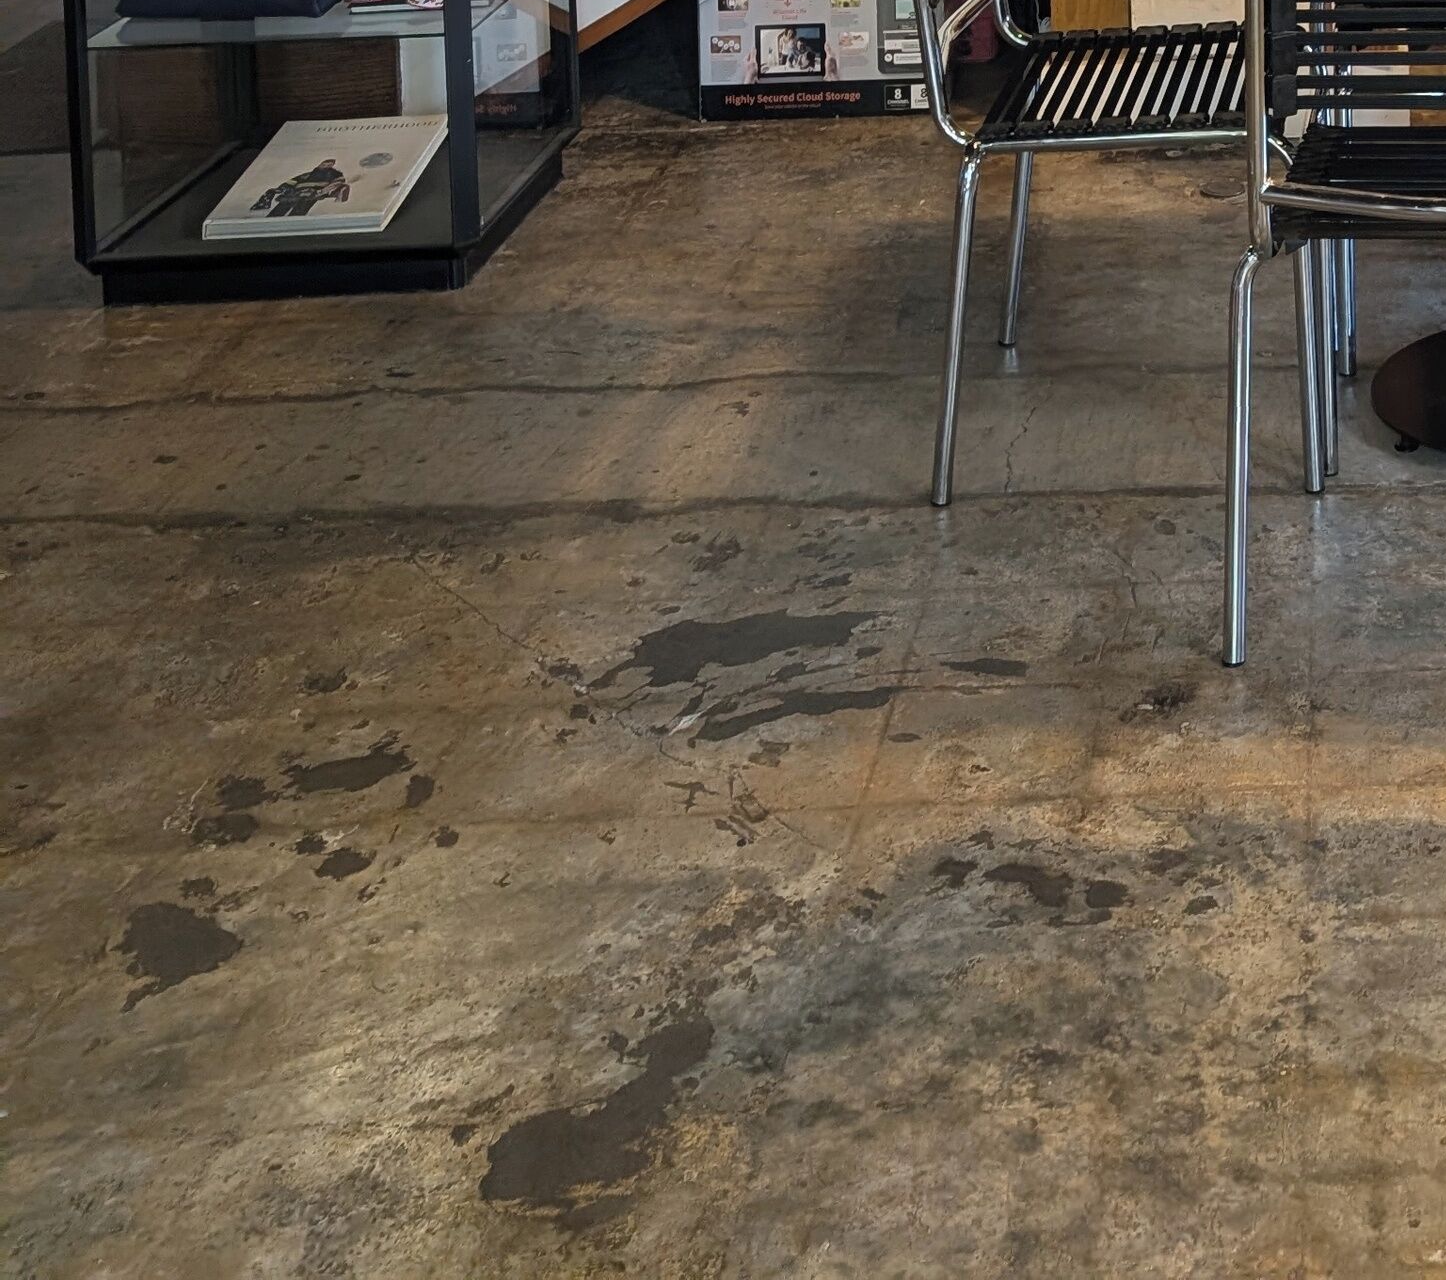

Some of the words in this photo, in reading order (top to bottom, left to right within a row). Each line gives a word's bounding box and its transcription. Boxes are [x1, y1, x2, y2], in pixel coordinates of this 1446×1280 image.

[725, 94, 755, 106] Highly
[757, 93, 795, 104] Secured
[796, 91, 824, 102] Cloud
[825, 91, 861, 103] Storage
[894, 88, 902, 99] 8
